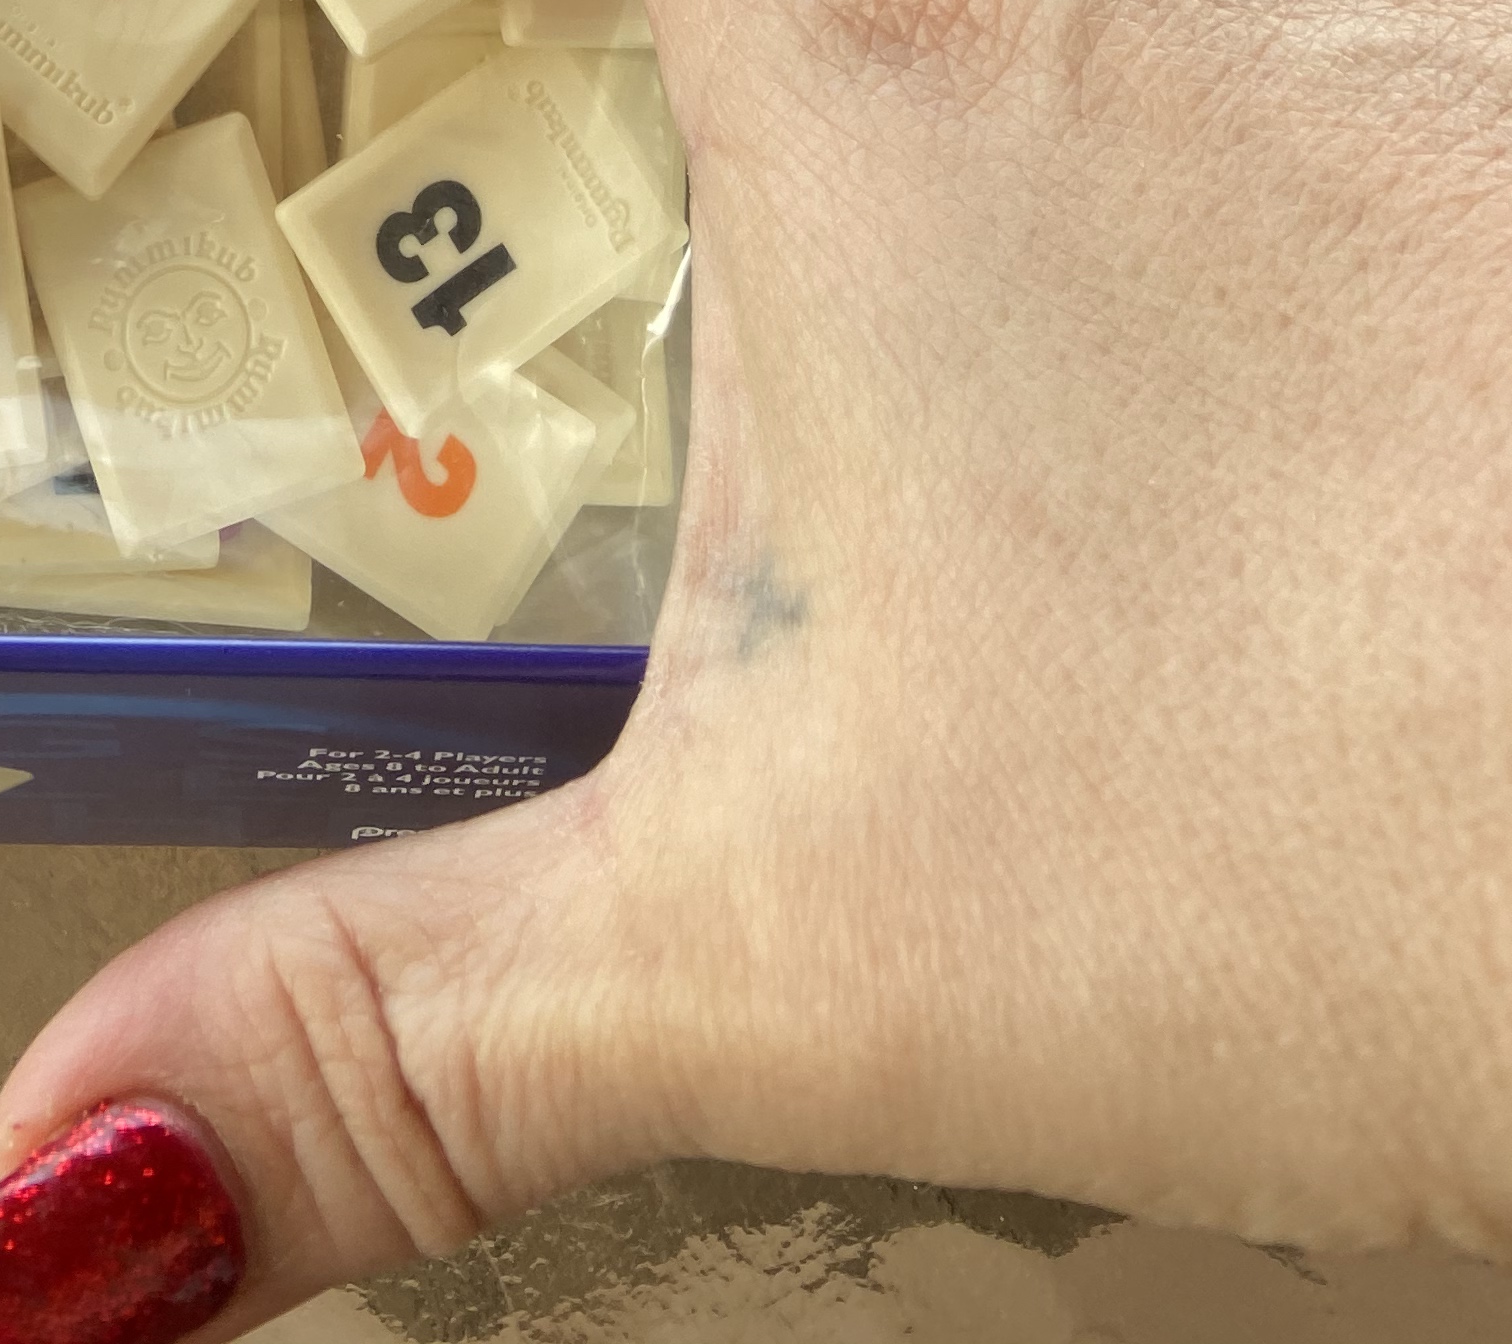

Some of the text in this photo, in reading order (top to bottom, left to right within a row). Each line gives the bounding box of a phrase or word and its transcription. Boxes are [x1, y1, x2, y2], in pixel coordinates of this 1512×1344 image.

[525, 78, 637, 255] Rummikub
[376, 179, 517, 337] 13
[309, 748, 548, 764] For 2-4 Players
[297, 760, 375, 773] Ages
[415, 763, 447, 773] to
[453, 764, 545, 776] Adult
[257, 770, 331, 781] Pour
[341, 772, 358, 782] 2
[396, 774, 413, 784] 4
[422, 775, 541, 786] joueurs
[372, 786, 423, 794] ans
[433, 787, 466, 796] et
[474, 787, 539, 799] plus
